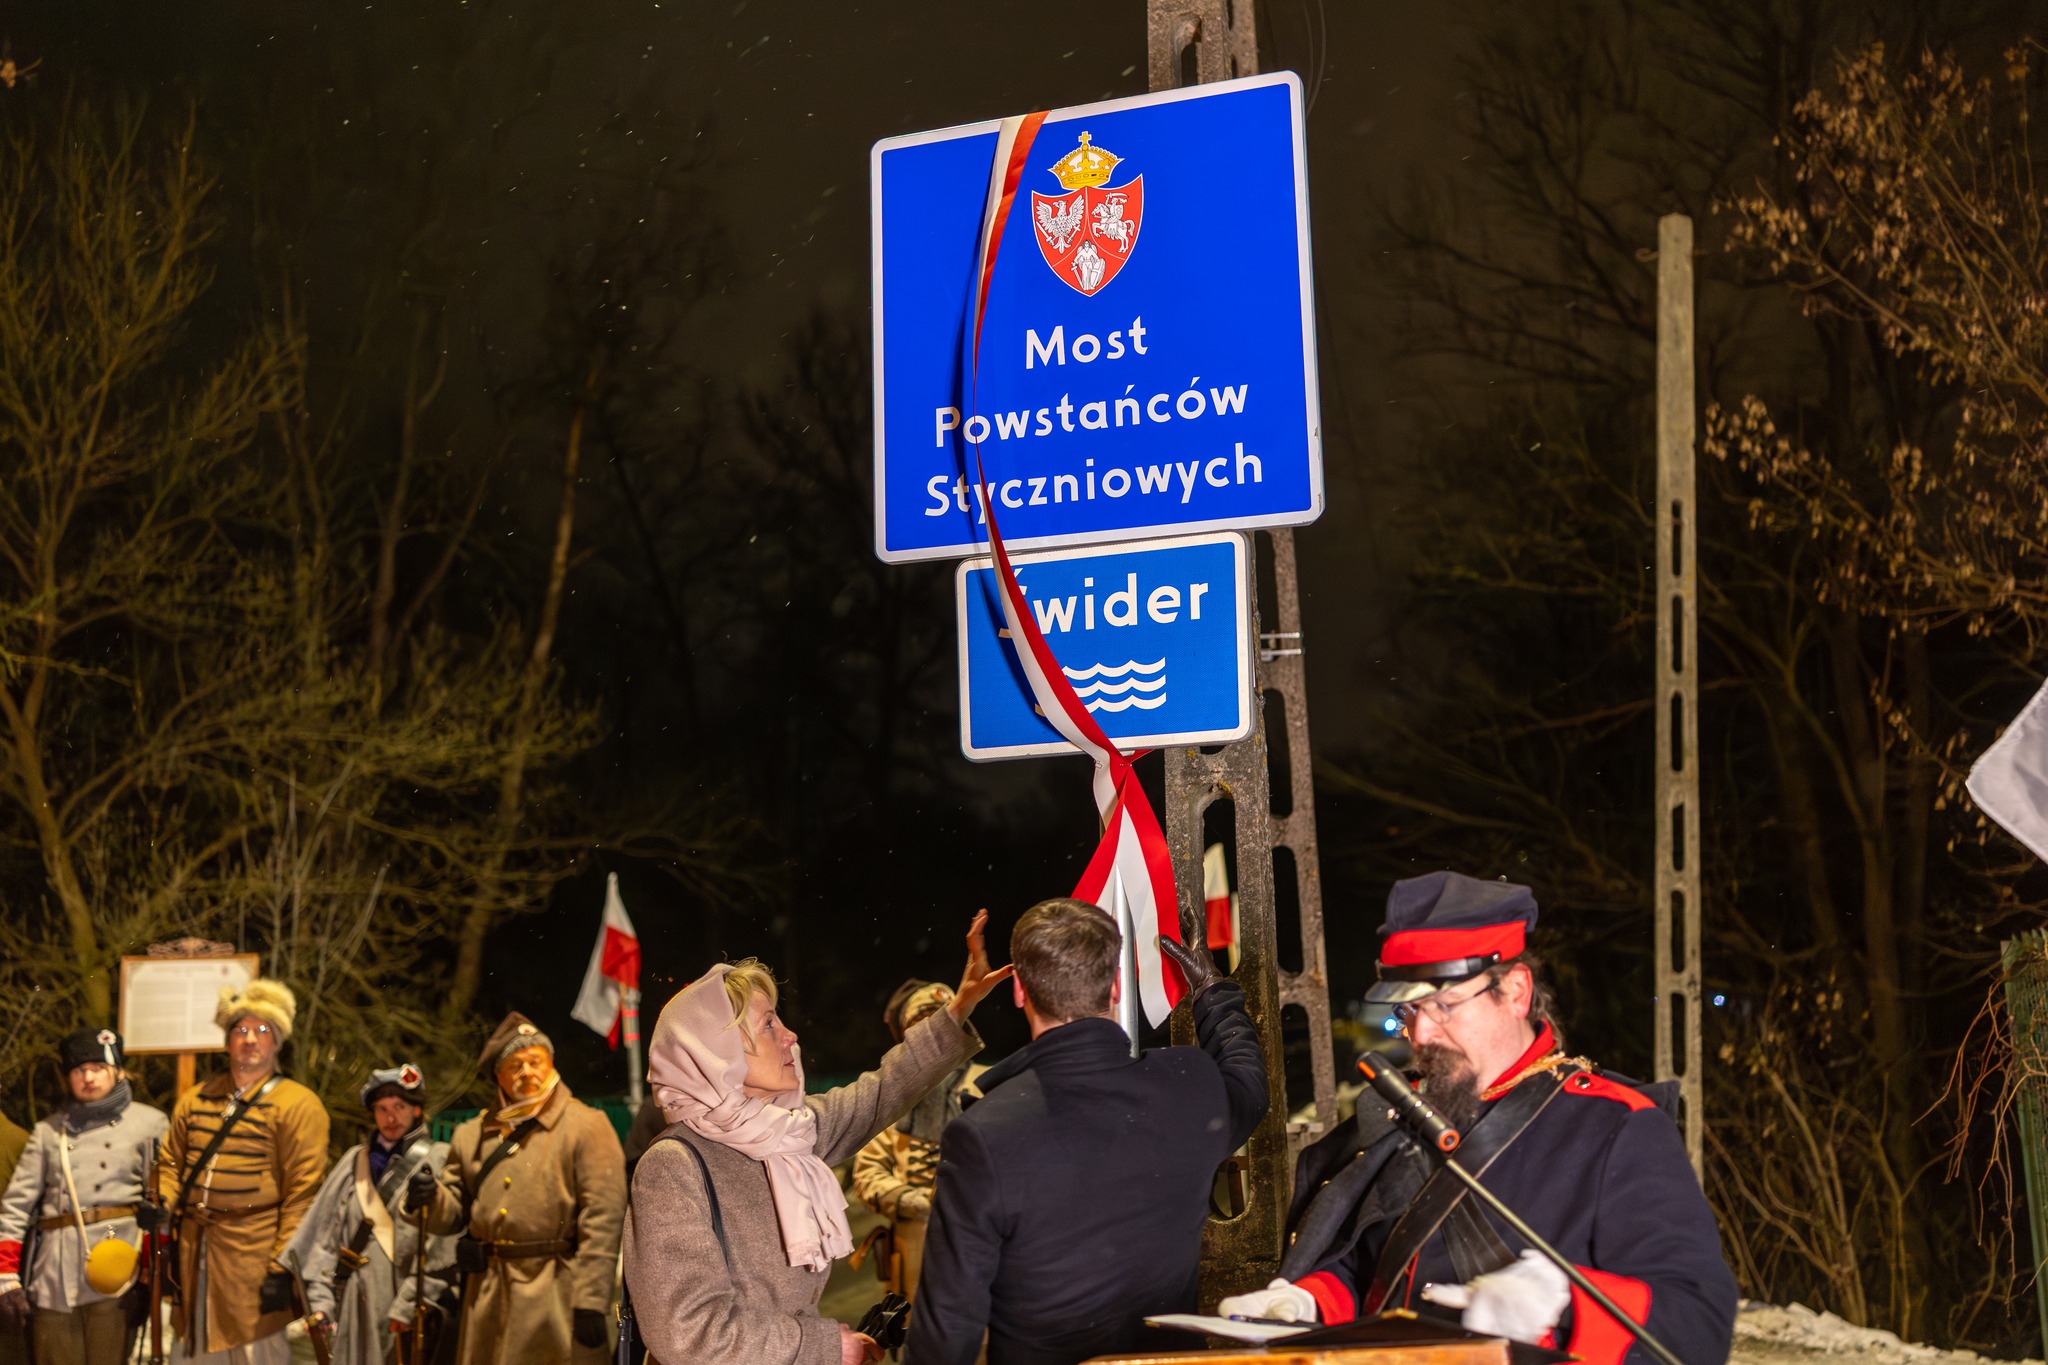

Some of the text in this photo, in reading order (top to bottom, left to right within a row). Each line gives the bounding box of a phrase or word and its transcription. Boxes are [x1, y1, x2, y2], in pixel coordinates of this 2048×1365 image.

[1025, 315, 1148, 370] Most
[935, 376, 1249, 448] Powstańców
[924, 442, 1263, 525] Styczniowych
[998, 567, 1209, 638] wider
